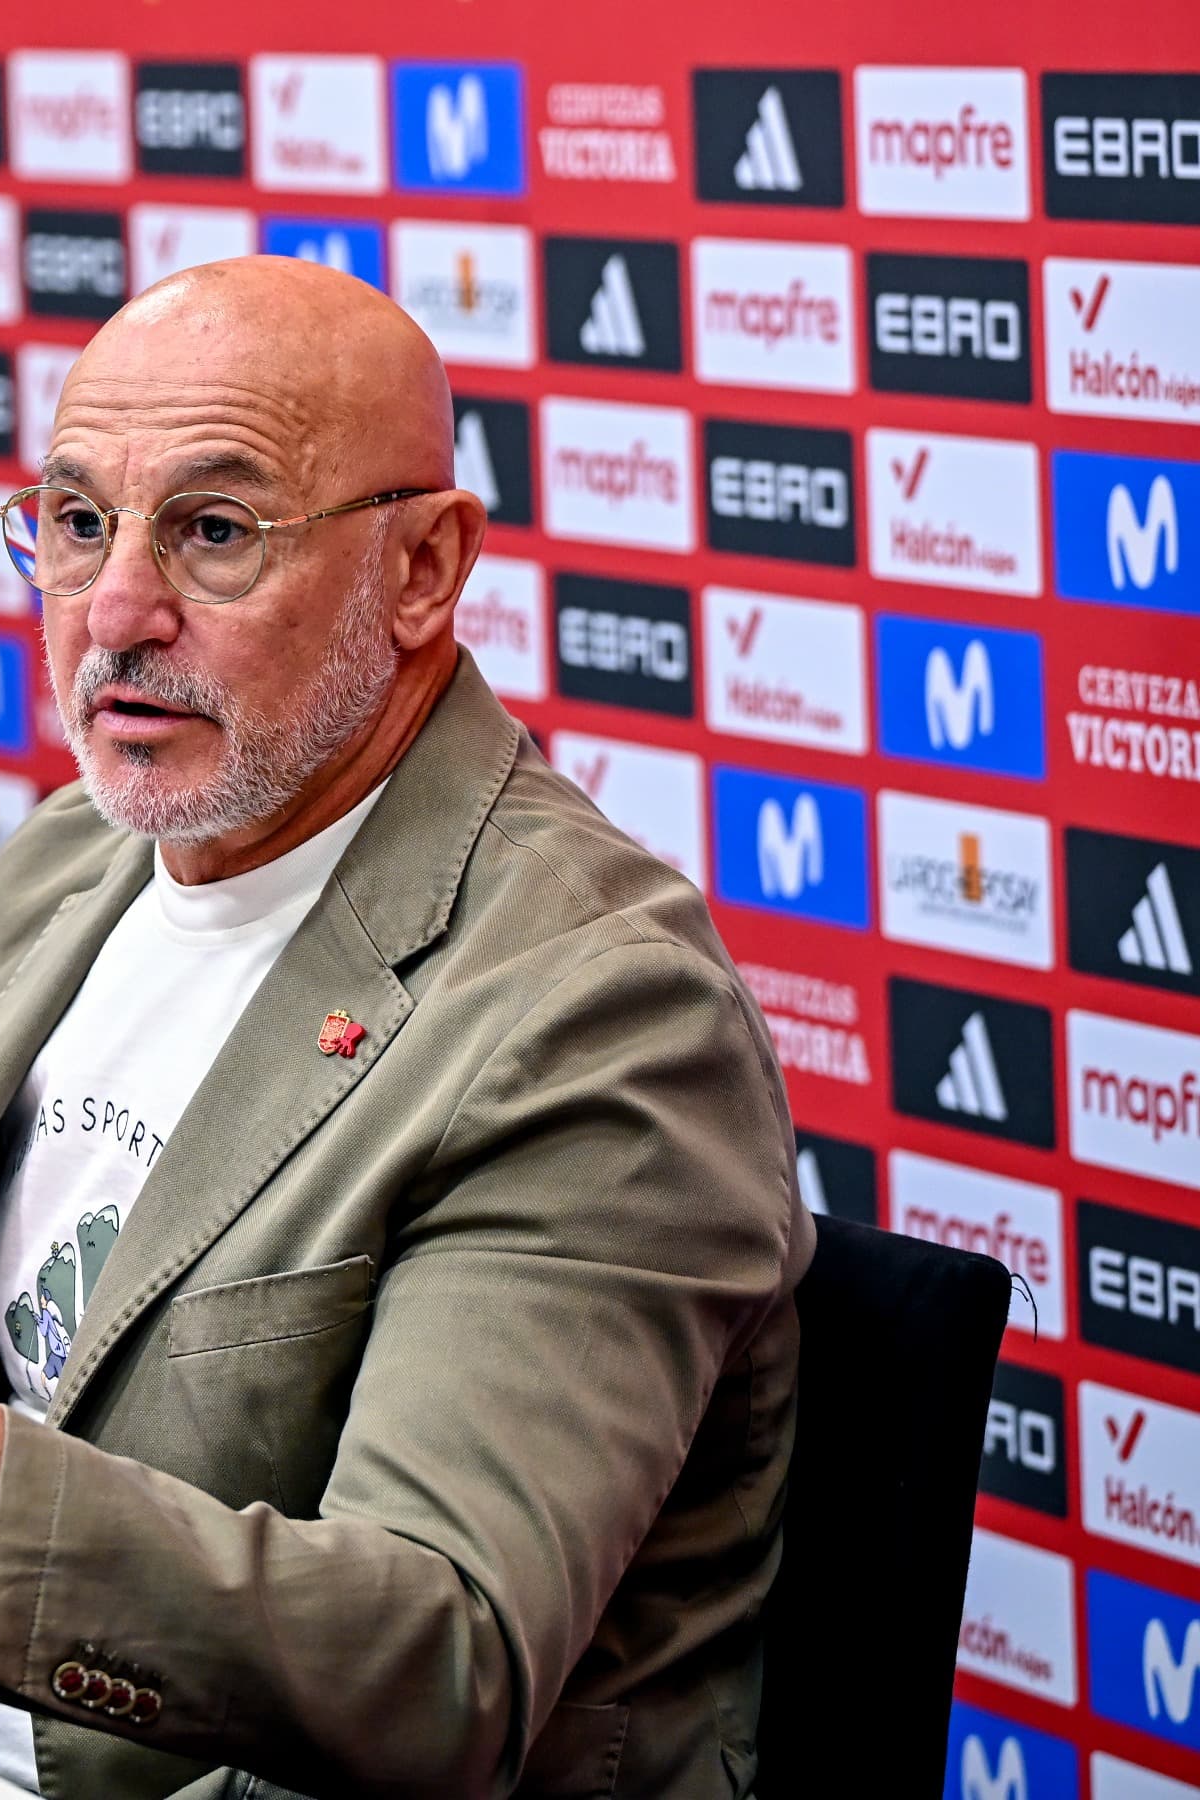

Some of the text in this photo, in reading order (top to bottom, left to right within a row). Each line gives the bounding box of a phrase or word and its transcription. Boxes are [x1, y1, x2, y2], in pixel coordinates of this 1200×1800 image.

[868, 104, 1014, 178] mapfre
[705, 279, 841, 348] mapfre
[1069, 349, 1160, 400] Halcón
[1104, 1475, 1196, 1547] Halcón
